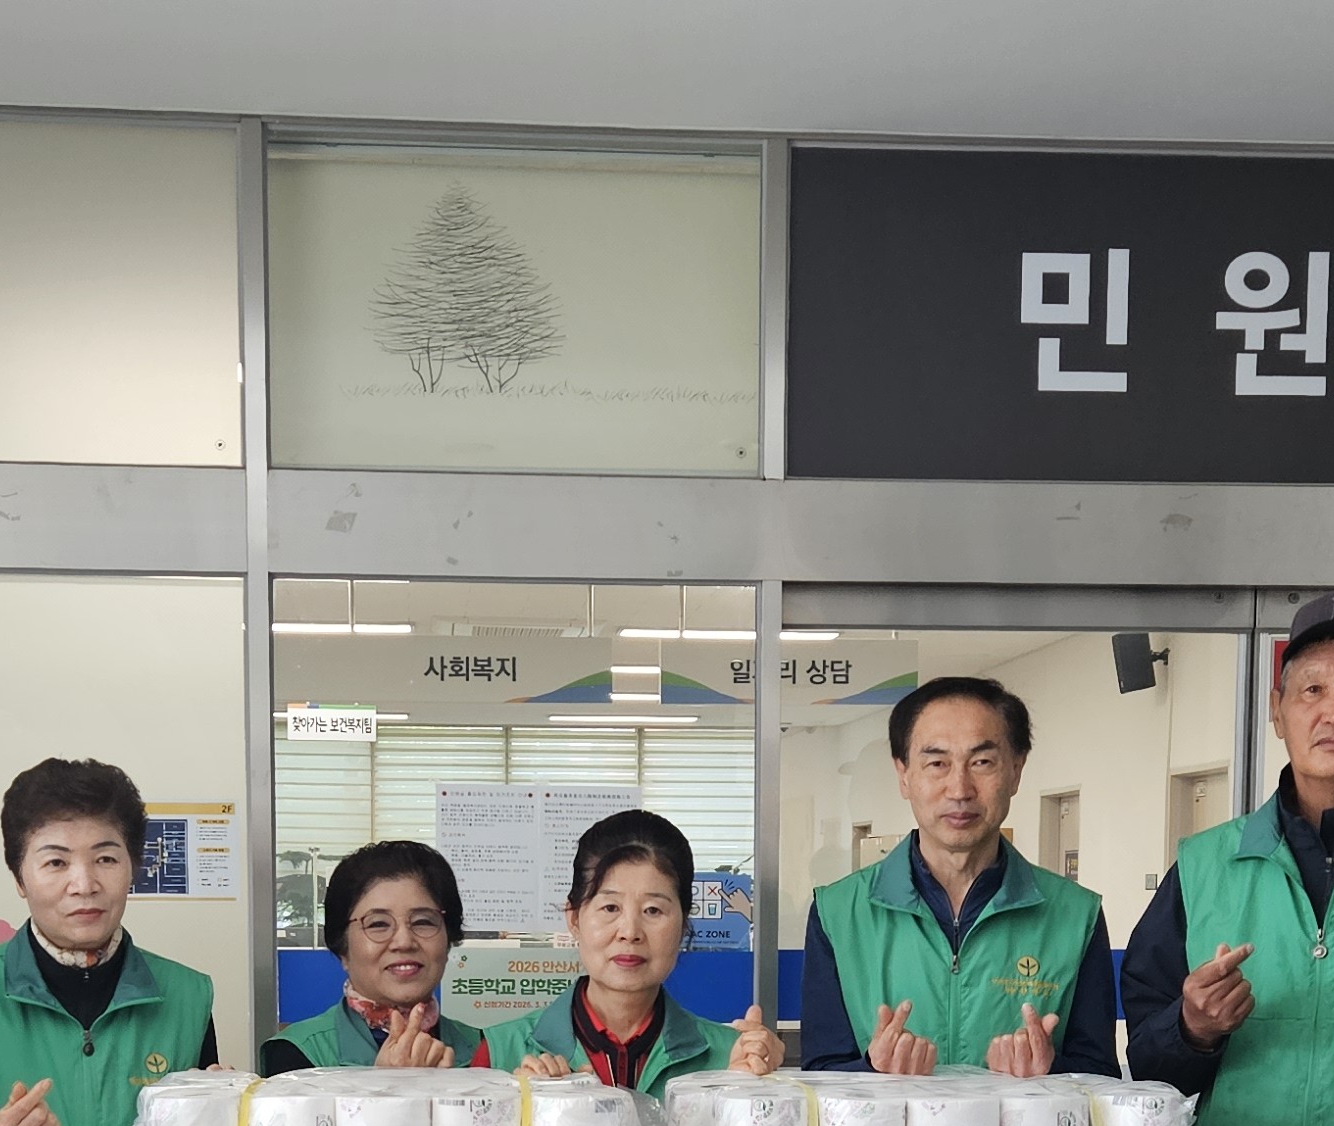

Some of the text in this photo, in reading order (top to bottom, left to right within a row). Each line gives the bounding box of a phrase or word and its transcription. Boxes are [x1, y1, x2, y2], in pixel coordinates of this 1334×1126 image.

[423, 655, 517, 682] 사회복지
[730, 658, 852, 685] 일리 상담
[291, 716, 373, 735] 찾아가는 보건복지팀
[221, 805, 233, 813] 2F
[705, 930, 731, 938] ZONE
[508, 961, 540, 973] 2026
[451, 978, 572, 995] 초등학교 입학준
